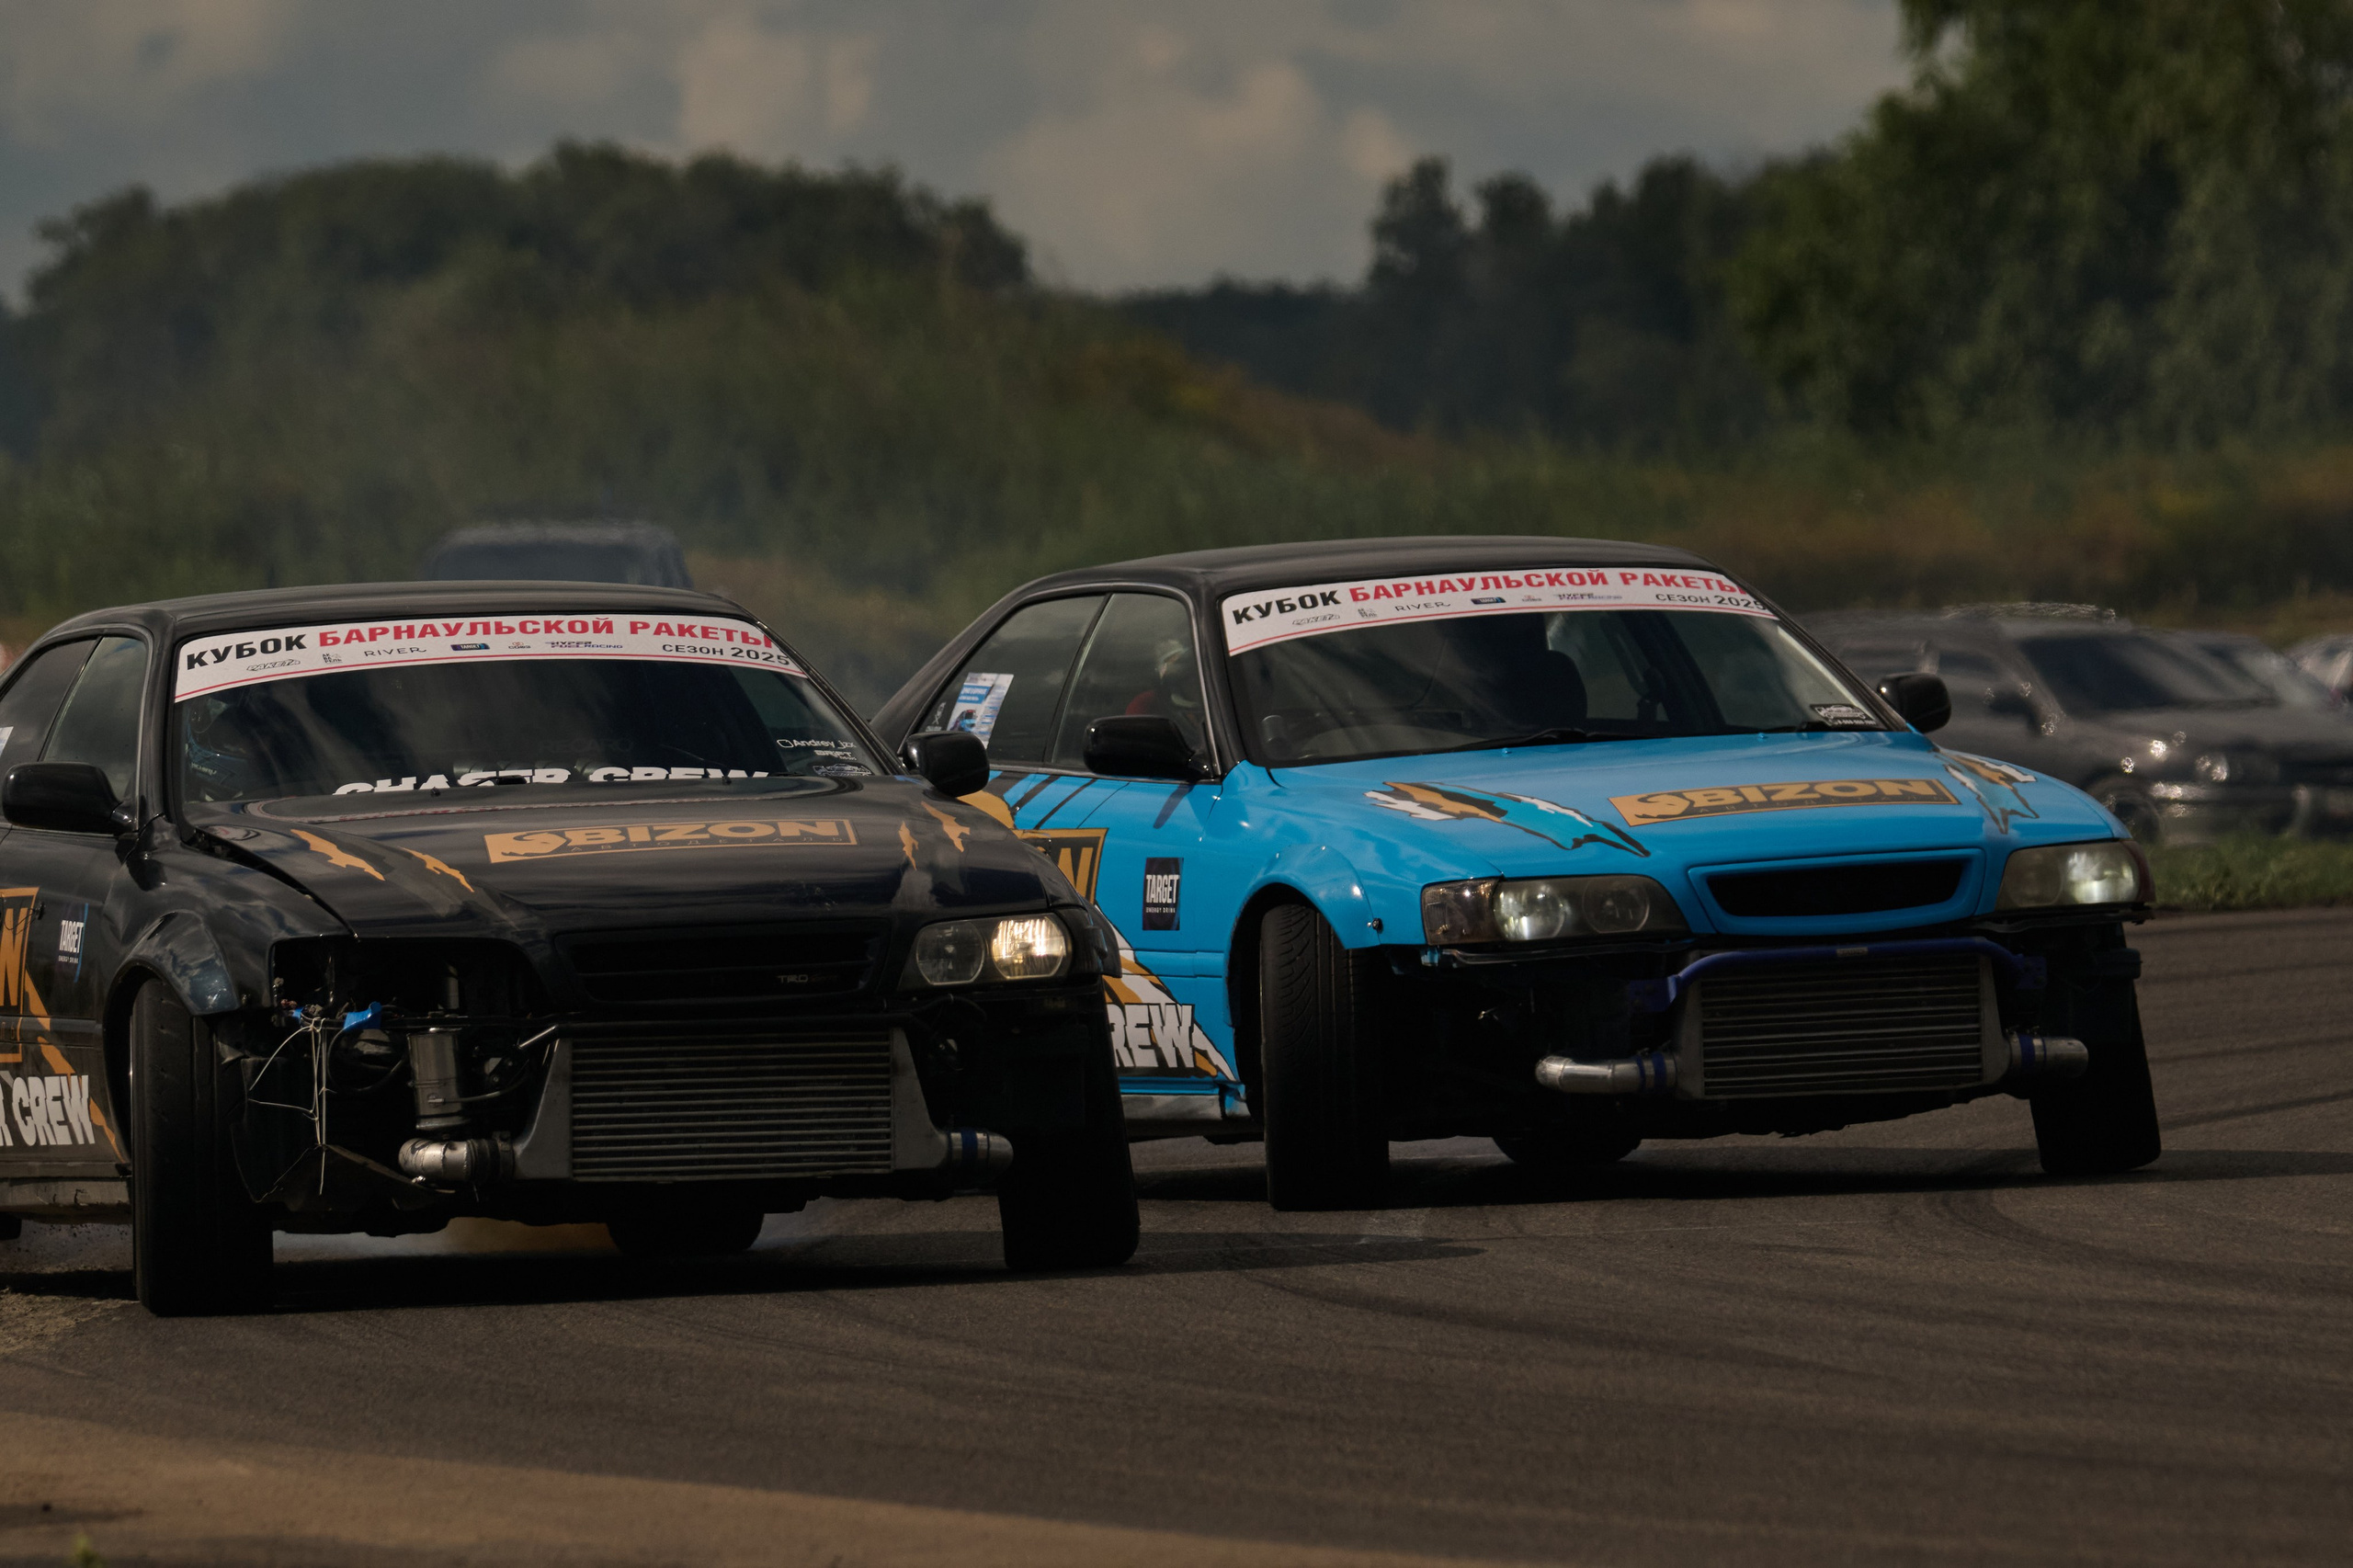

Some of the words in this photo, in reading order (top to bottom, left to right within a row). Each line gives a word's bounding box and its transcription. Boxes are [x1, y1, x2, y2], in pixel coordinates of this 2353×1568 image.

[1233, 590, 1341, 625] КУБОК
[1349, 569, 1608, 602] БАРНАУЛЬСКОЙ
[1620, 572, 1746, 595] РАКЕТЫ
[1395, 601, 1450, 611] RIVER
[1655, 593, 1711, 604] СЕЗОН
[1714, 595, 1767, 609] 2025
[187, 634, 307, 670] КУБОК
[319, 617, 614, 647] БАРНАУЛЬСКОЙ
[630, 620, 773, 649] РАКЕТЫ
[364, 647, 427, 657] RIVER
[662, 644, 724, 656] СЕЗОН
[730, 647, 790, 665] 2025
[1682, 779, 1938, 807] BIZON
[563, 821, 839, 846] BIZON
[1145, 874, 1180, 903] TARGET
[59, 919, 85, 953] TARGET
[1107, 1003, 1195, 1068] REW
[12, 1074, 95, 1146] CREW
